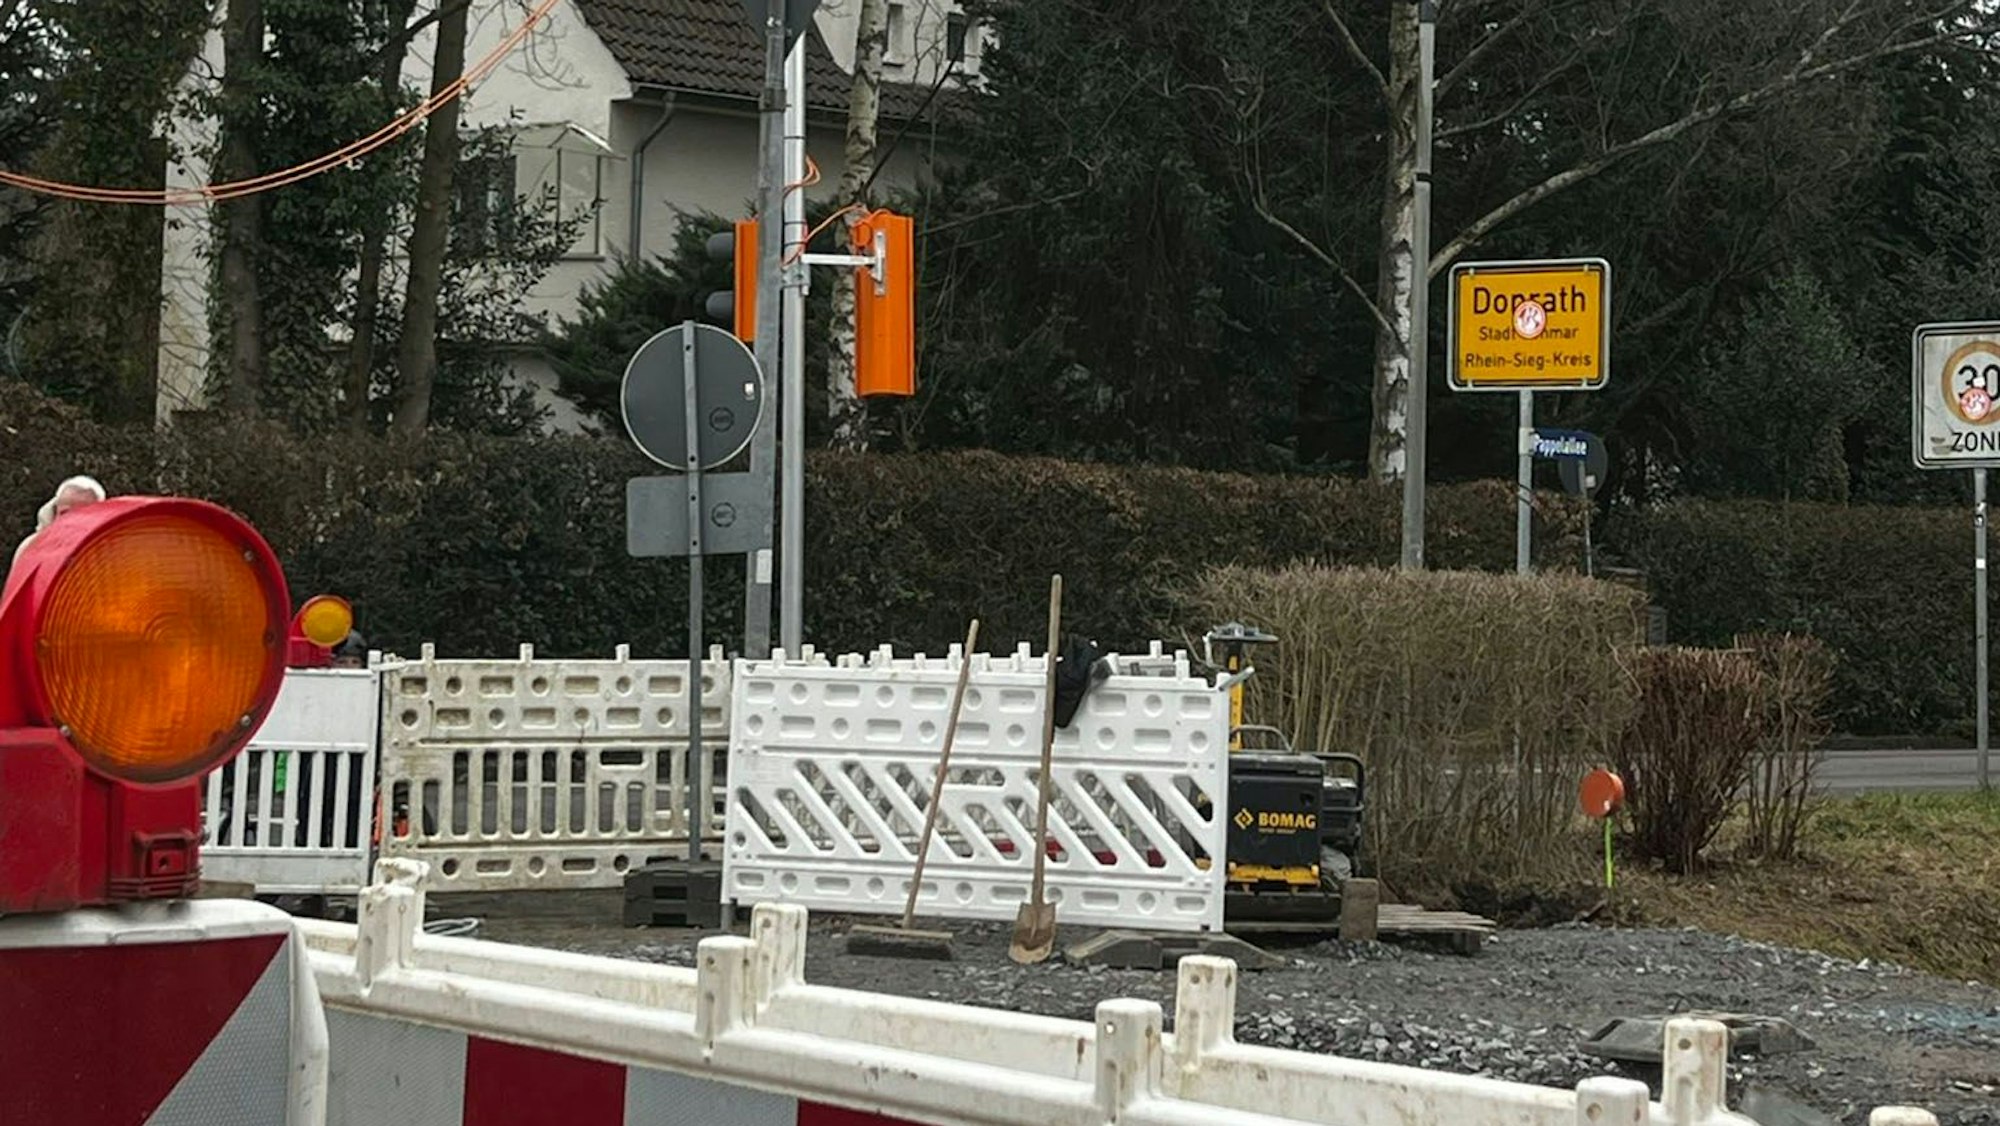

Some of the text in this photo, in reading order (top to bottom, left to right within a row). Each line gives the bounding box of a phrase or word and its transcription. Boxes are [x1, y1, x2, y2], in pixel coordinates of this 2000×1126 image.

[1465, 352, 1592, 371] Rhein-Sieg-Kreis
[1951, 430, 2000, 453] ZON
[1258, 811, 1317, 830] BOMAG
